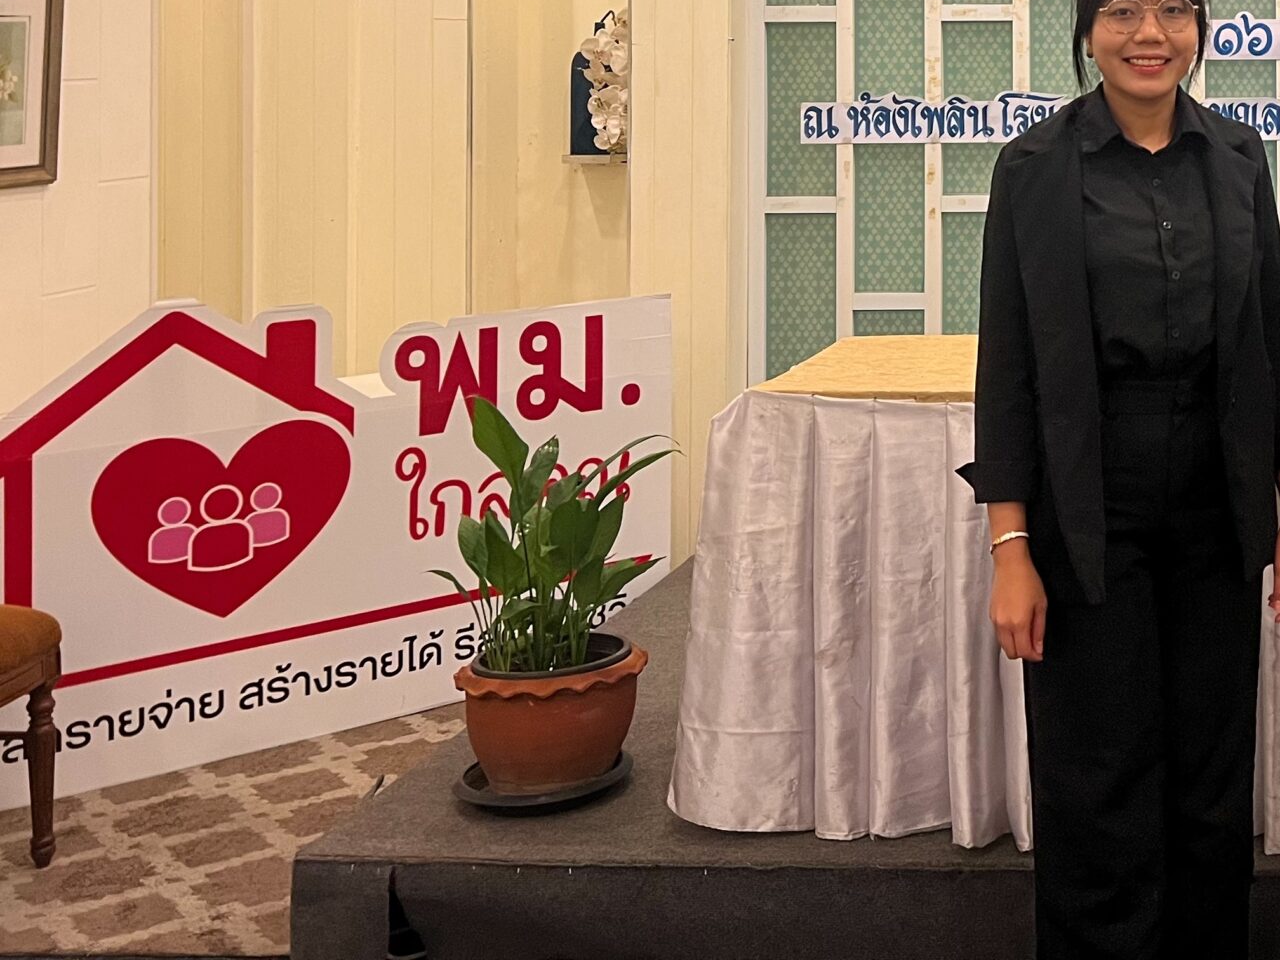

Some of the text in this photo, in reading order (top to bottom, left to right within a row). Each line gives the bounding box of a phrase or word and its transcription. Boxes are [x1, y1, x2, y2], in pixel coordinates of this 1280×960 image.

[1213, 13, 1273, 57] ๑๖
[803, 105, 840, 139] ณ
[846, 92, 995, 139] ห้องไพลิน
[394, 314, 641, 436] พม.
[2, 629, 444, 764] ลรายจ่าย สร้างรายได้
